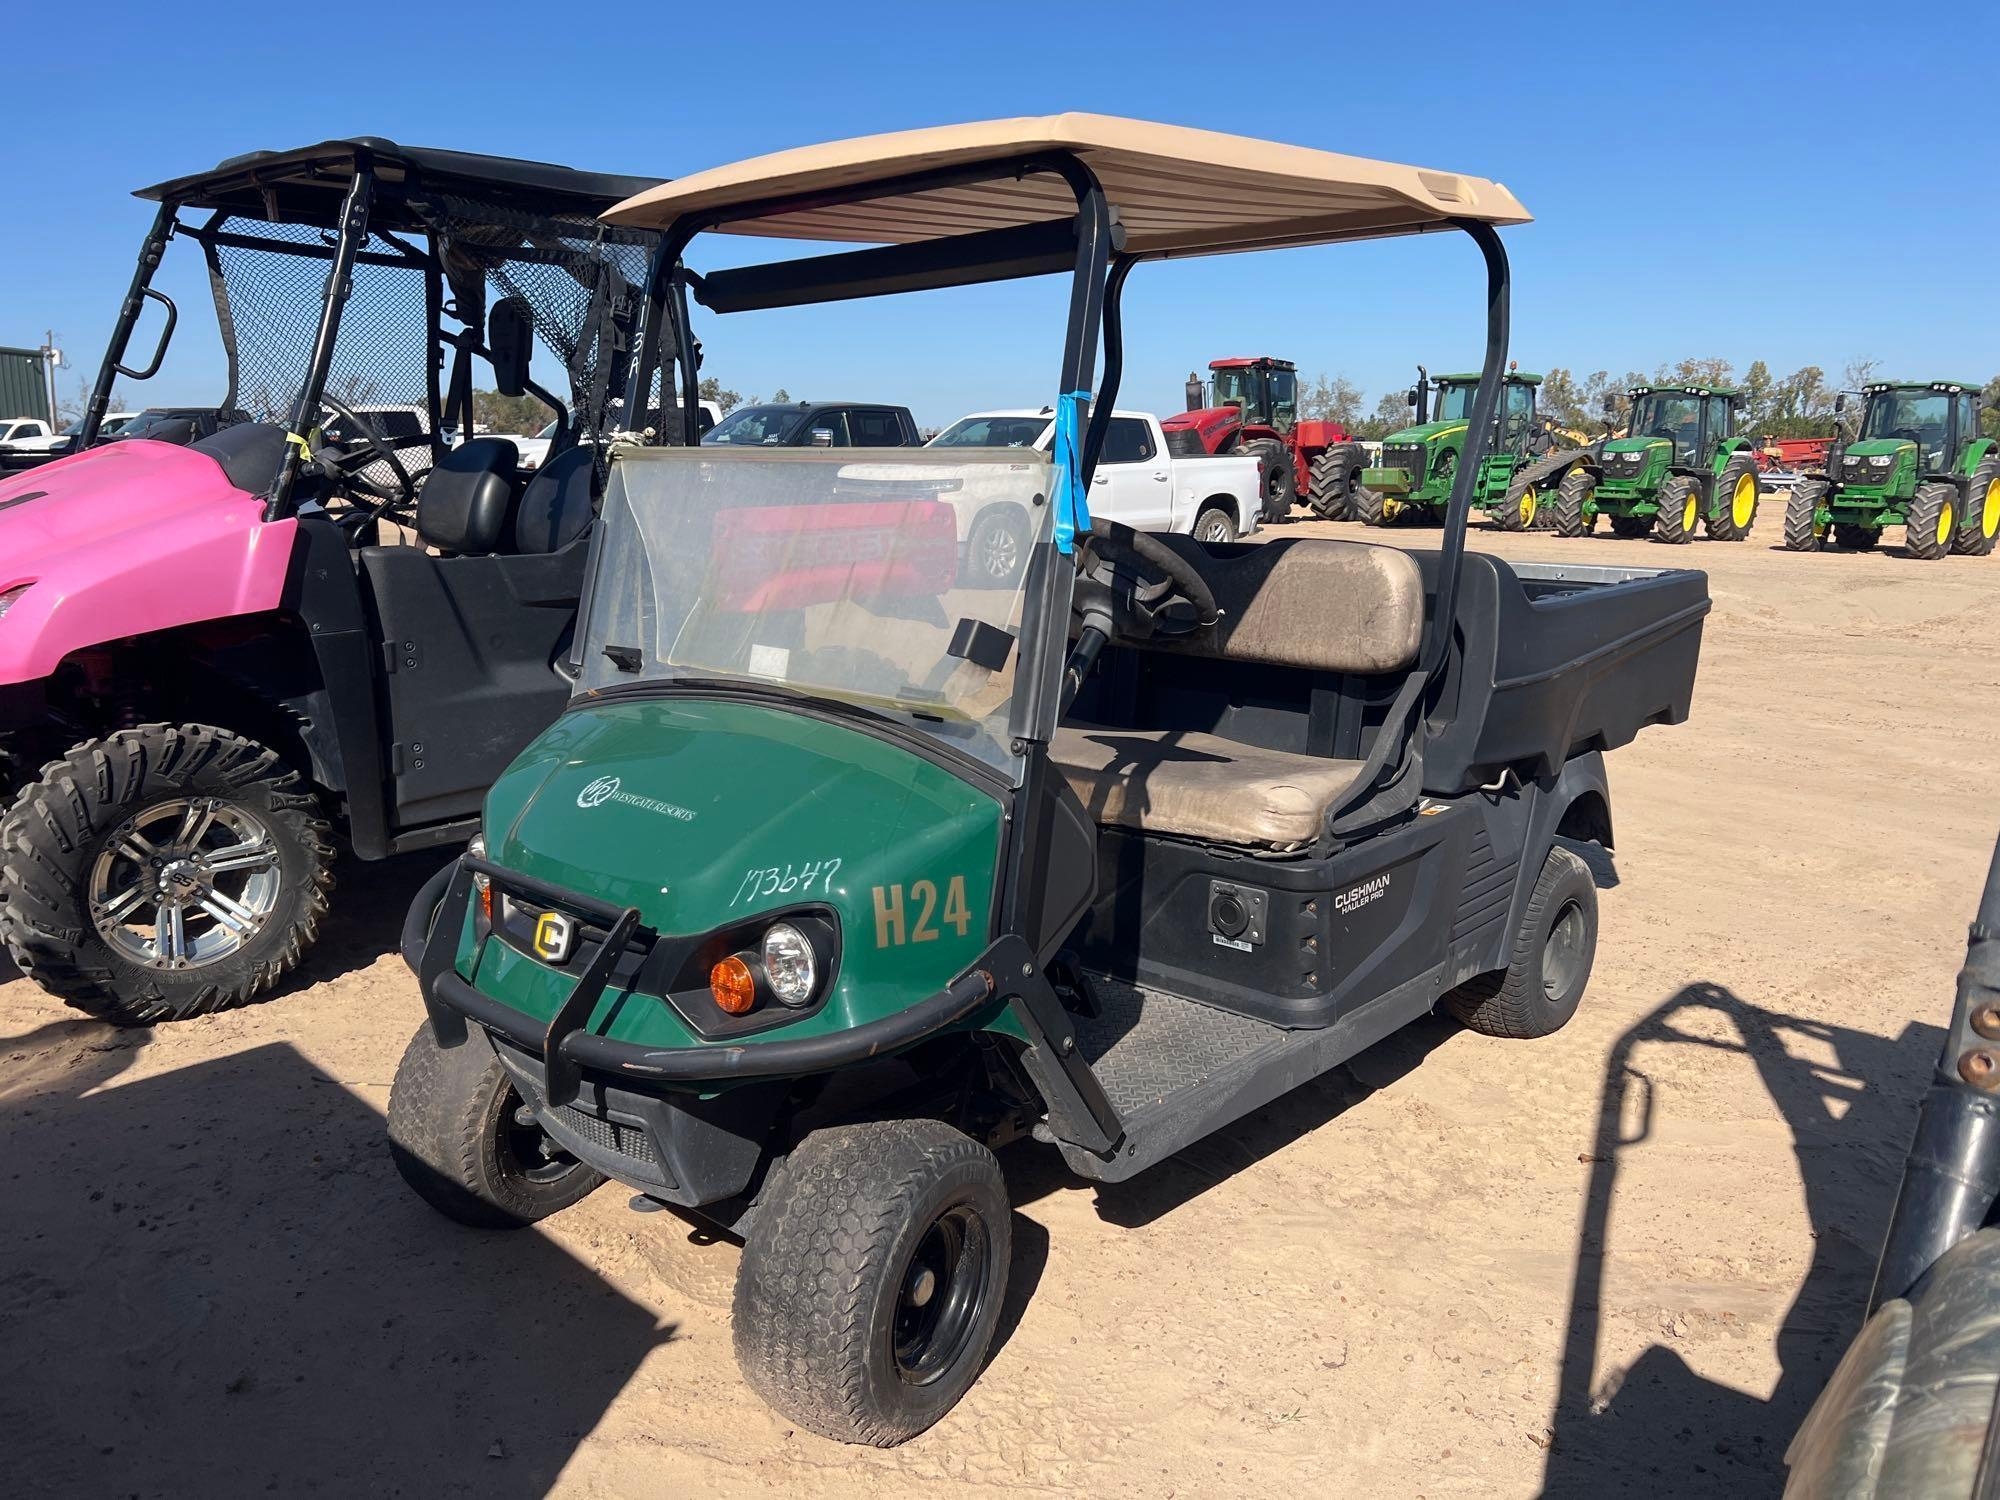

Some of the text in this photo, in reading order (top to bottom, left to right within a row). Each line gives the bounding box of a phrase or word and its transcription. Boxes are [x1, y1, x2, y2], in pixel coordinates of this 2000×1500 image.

[611, 791, 695, 821] WESTGATE RESORTS
[729, 858, 842, 907] 173647
[1335, 873, 1390, 909] CUSHMAN
[872, 875, 972, 948] H24
[1341, 888, 1384, 915] HAULER PRO
